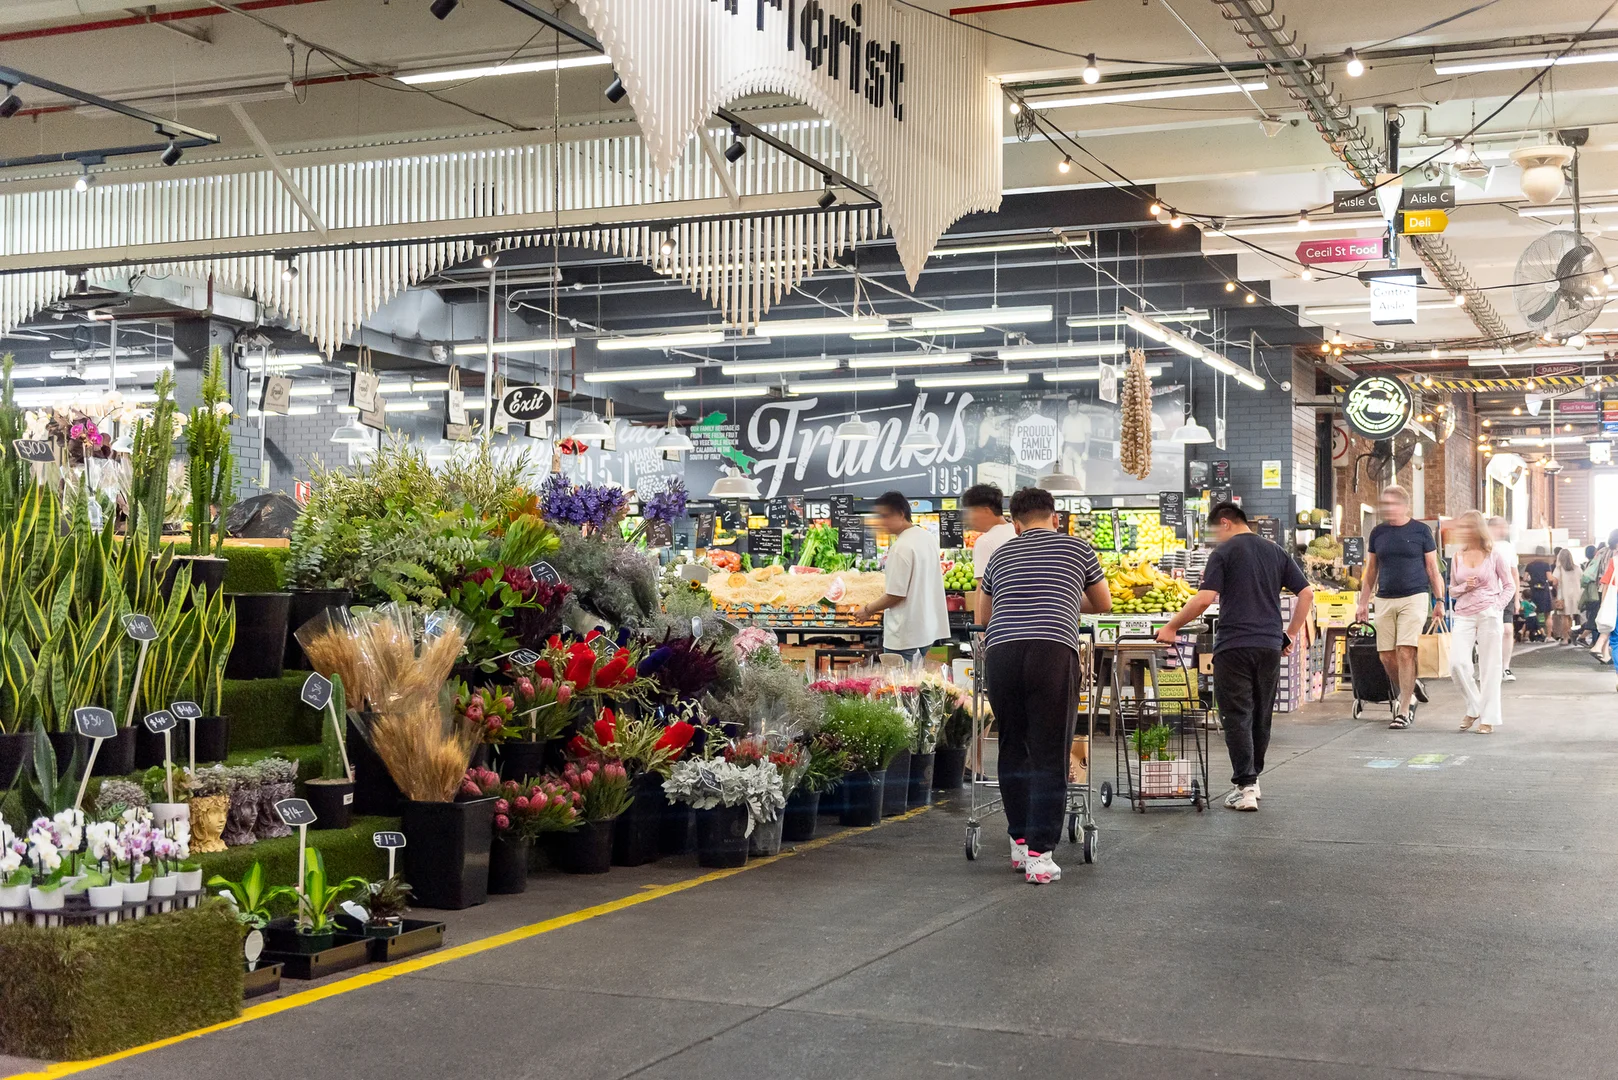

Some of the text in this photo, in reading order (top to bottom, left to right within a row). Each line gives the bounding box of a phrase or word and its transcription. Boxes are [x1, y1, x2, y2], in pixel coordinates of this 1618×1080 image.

[1338, 195, 1378, 208] Aisle C
[1410, 192, 1449, 204] Aisle C
[1409, 217, 1431, 228] Deli
[1305, 243, 1378, 258] Cecil St Food
[1373, 288, 1411, 298] Centre
[509, 391, 545, 414] Exit
[1017, 425, 1056, 437] PROUDLY
[18, 440, 47, 458] $100
[748, 392, 975, 500] Frank's
[1021, 437, 1052, 449] FAMILY
[628, 447, 663, 463] MARKE
[1020, 448, 1052, 461] OWNED
[634, 460, 665, 475] FRESH
[928, 465, 974, 496] 1951
